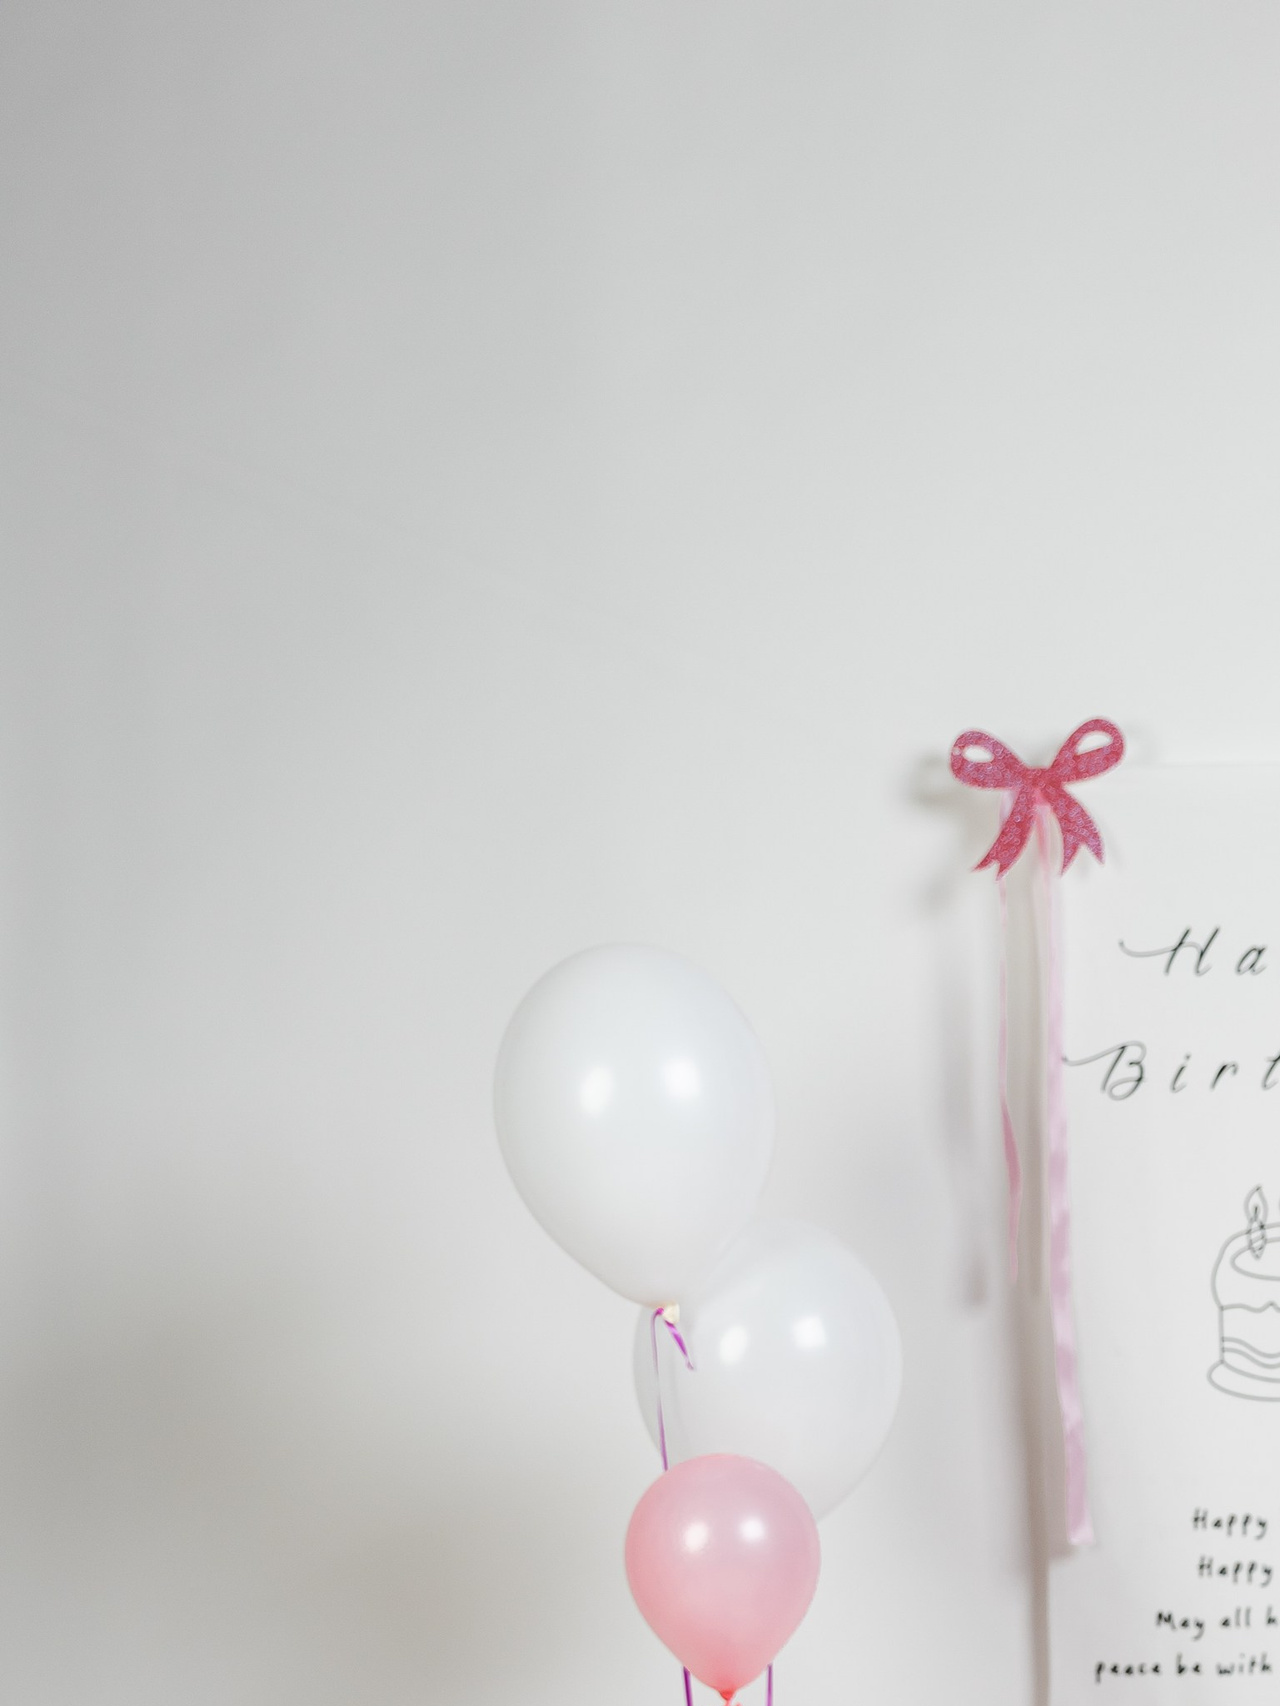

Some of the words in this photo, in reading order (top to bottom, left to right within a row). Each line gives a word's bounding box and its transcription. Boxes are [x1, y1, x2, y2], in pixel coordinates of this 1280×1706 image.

[1192, 1507, 1268, 1540] Happy
[1197, 1554, 1273, 1588] Happy
[1156, 1609, 1206, 1641] May
[1220, 1607, 1251, 1629] all
[1095, 1659, 1162, 1685] peace
[1175, 1651, 1202, 1676] be
[1216, 1651, 1273, 1676] with
